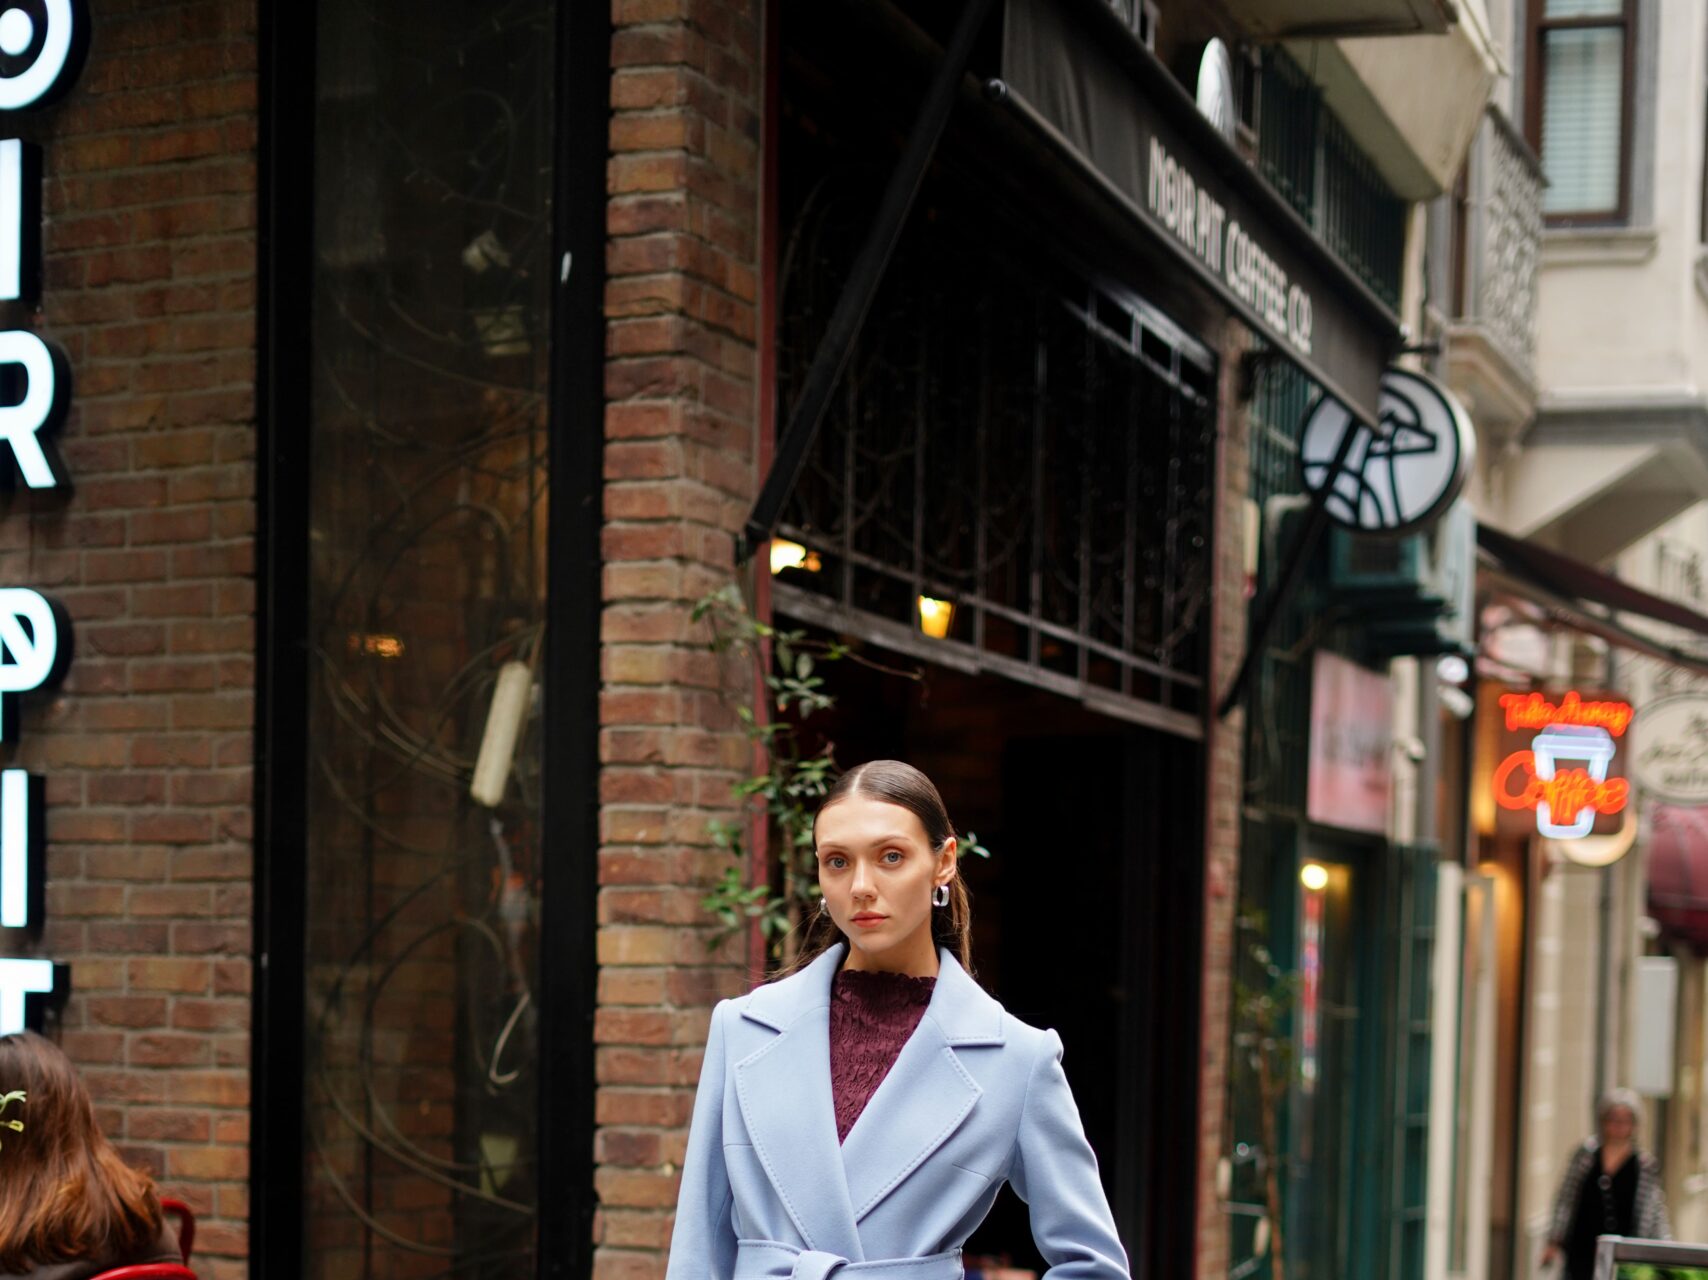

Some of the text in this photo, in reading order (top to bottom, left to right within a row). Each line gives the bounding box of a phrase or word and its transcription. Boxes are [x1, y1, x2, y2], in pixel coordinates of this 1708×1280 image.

[1197, 189, 1226, 273] PIT
[1226, 220, 1288, 334] COFFEE
[1491, 749, 1631, 827] Coffee
